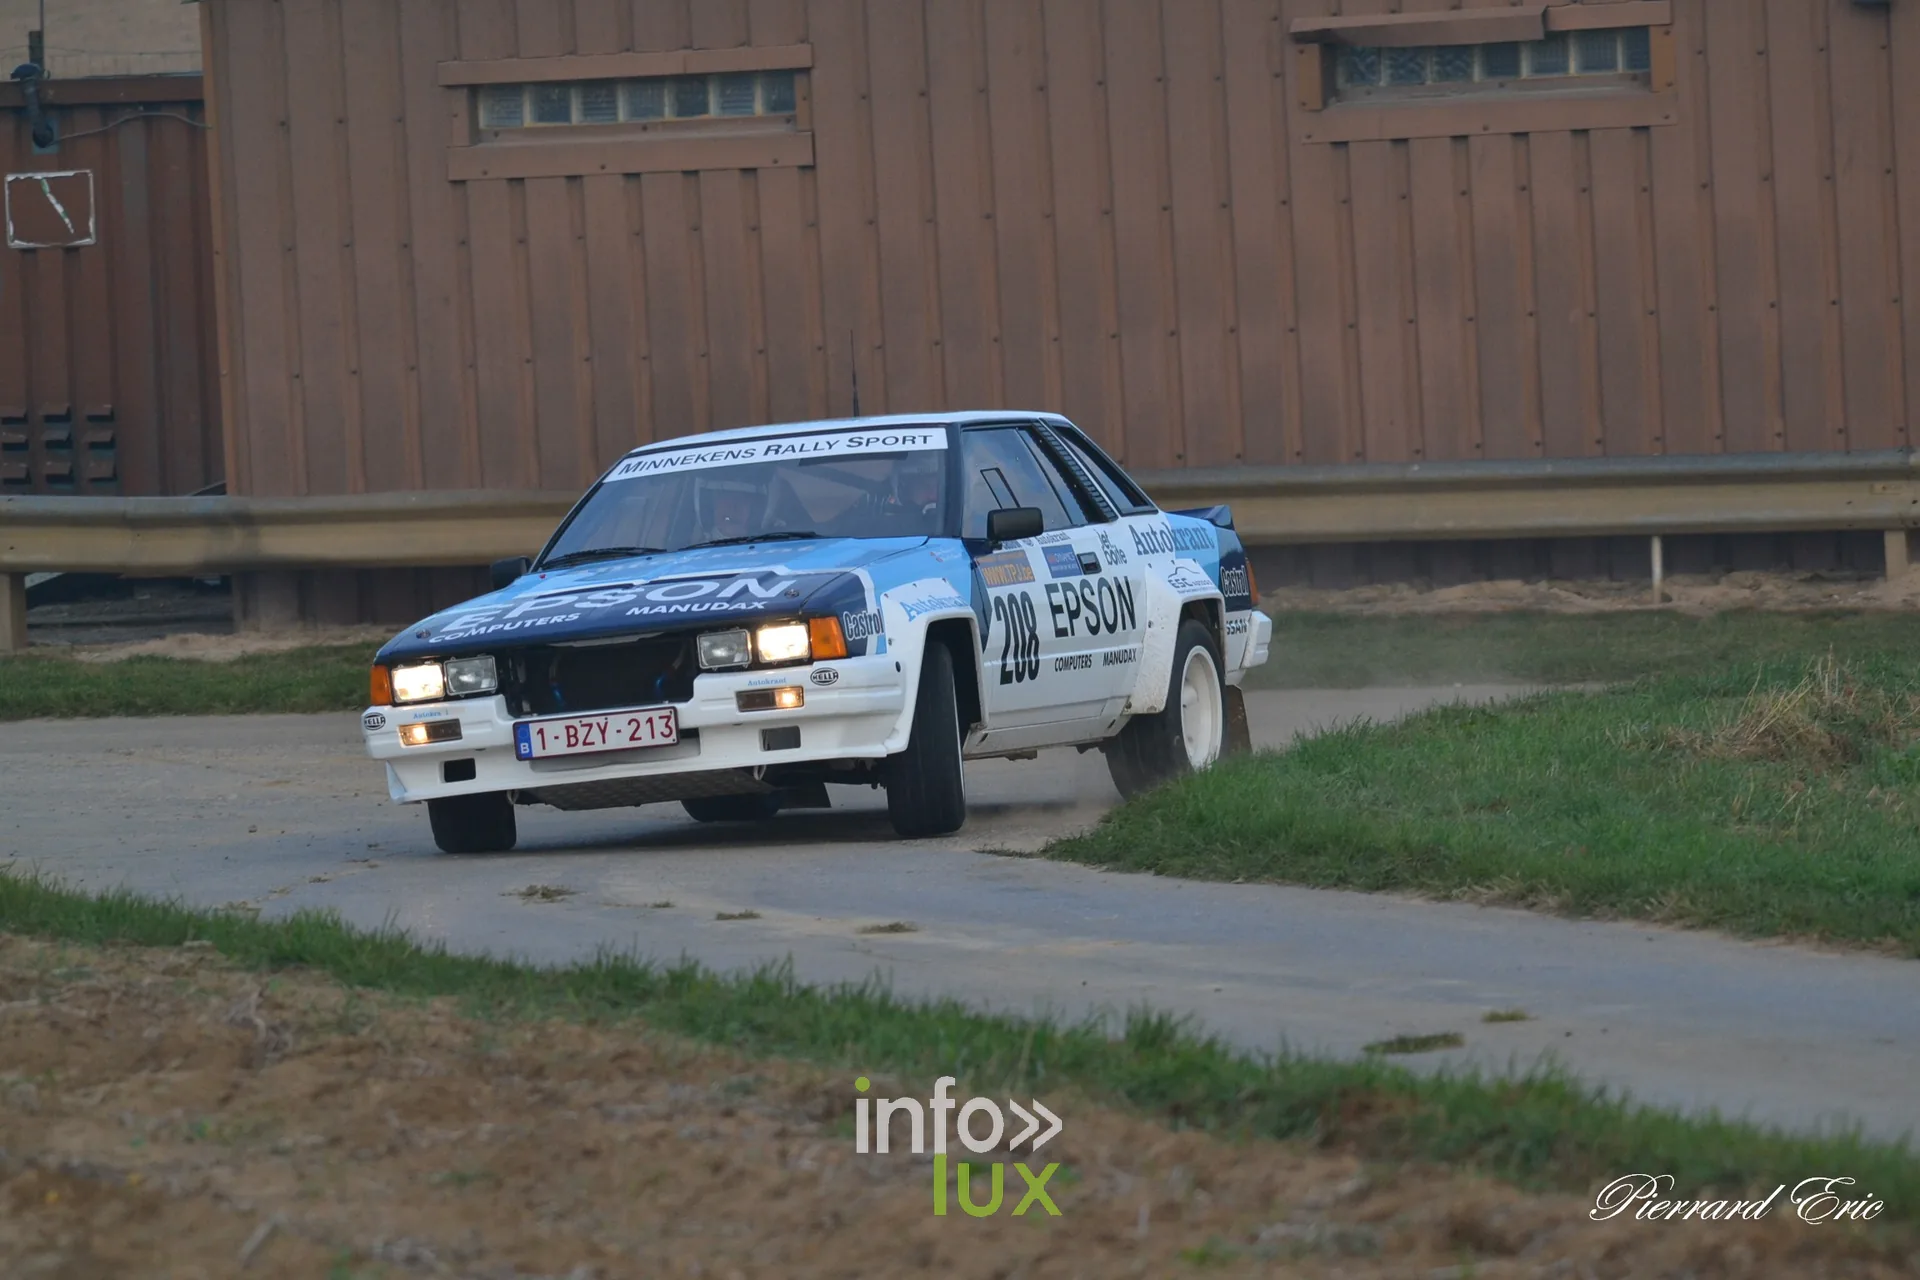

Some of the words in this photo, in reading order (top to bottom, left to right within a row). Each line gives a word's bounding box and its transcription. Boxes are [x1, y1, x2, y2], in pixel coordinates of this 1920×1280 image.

[617, 447, 756, 476] MINNEKENS
[762, 439, 840, 457] RALLY
[845, 434, 934, 449] SPORT
[1129, 521, 1216, 556] Autokrant
[1220, 564, 1250, 598] Castrol
[428, 612, 582, 644] COMPUTERS
[626, 600, 769, 616] MANUDAX
[439, 577, 797, 632] EPSON
[1044, 575, 1137, 639] EPSON
[843, 606, 885, 642] Castrol
[993, 590, 1040, 685] 208
[812, 670, 839, 682] HELLA
[1054, 653, 1093, 673] COMPUTERS
[1102, 648, 1137, 667] MANUDAX
[747, 677, 788, 687] Autokrant
[520, 743, 530, 754] B
[536, 714, 674, 751] 1-BZY-213
